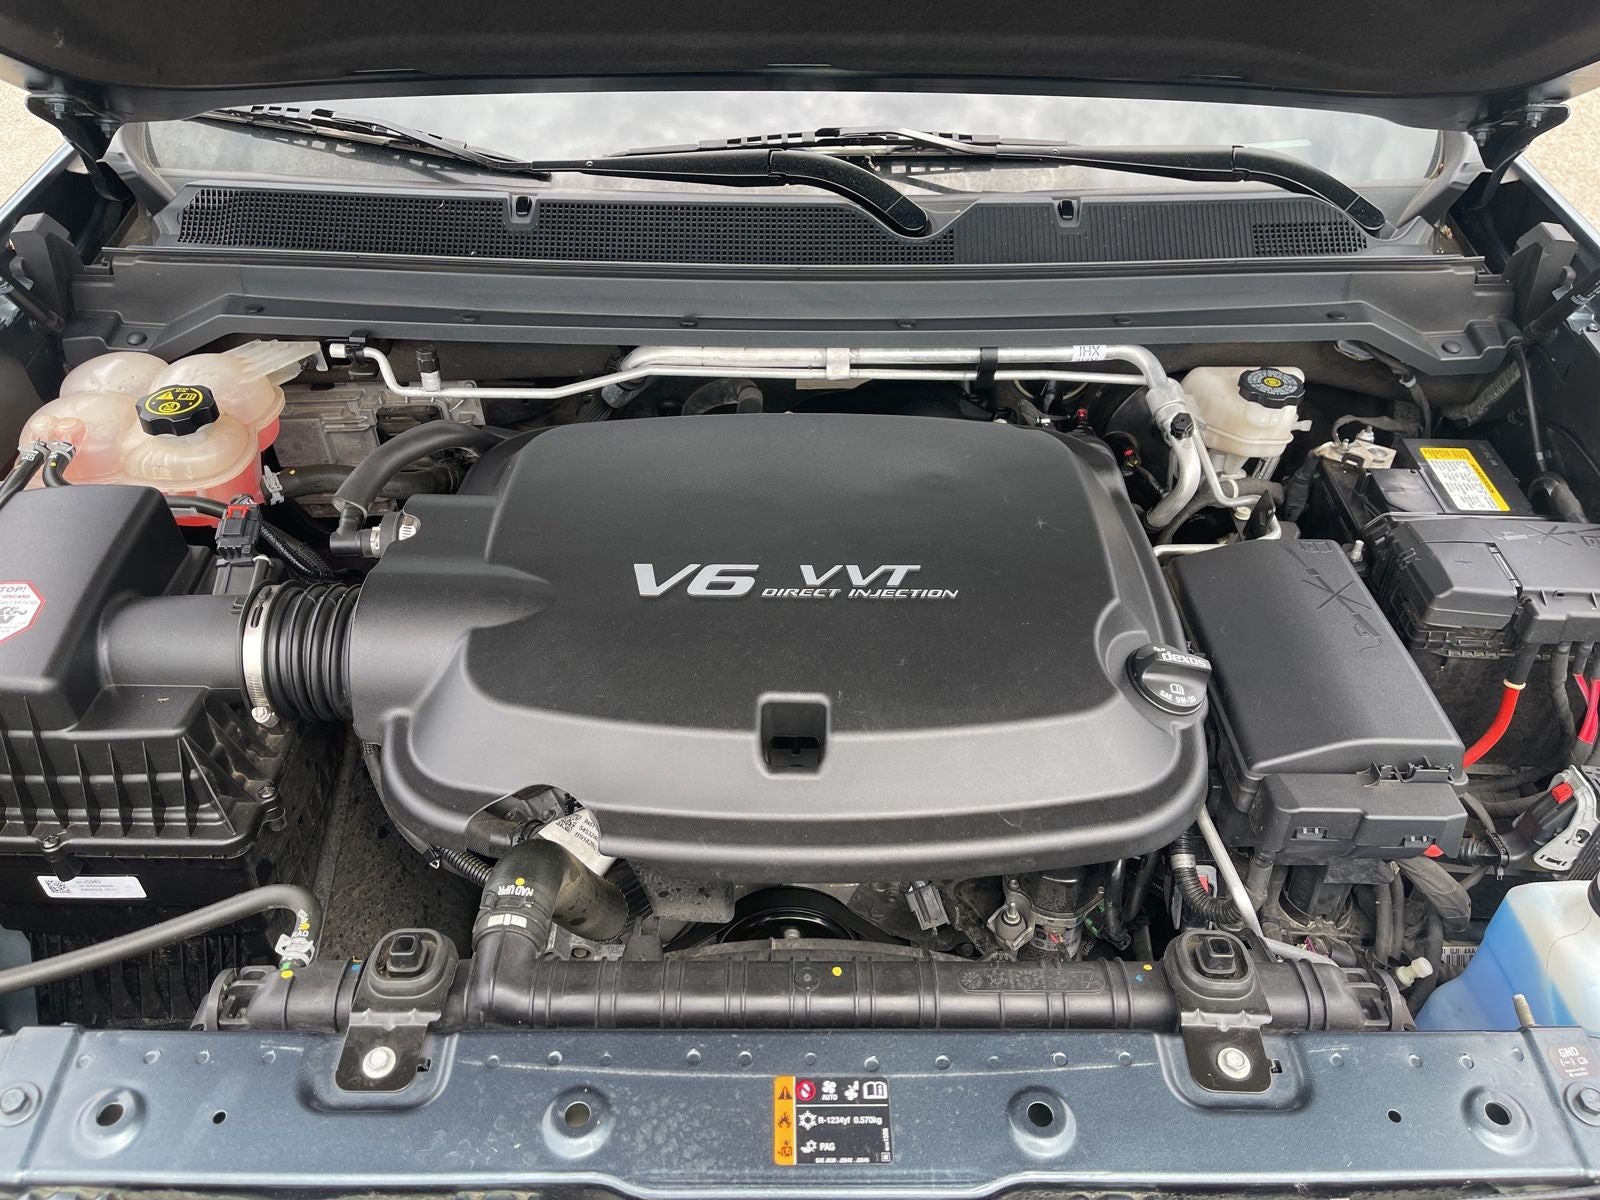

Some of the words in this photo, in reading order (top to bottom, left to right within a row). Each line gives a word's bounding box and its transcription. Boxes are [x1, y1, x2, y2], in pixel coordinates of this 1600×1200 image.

[1080, 346, 1100, 356] IHX
[633, 563, 759, 596] V6
[800, 564, 921, 586] VVT
[761, 588, 841, 597] DIRECT
[847, 588, 959, 599] INJECTION
[1161, 651, 1207, 668] dexos
[1160, 690, 1173, 700] SAE
[853, 1116, 883, 1126] 0.570kg
[819, 1142, 836, 1151] PAG
